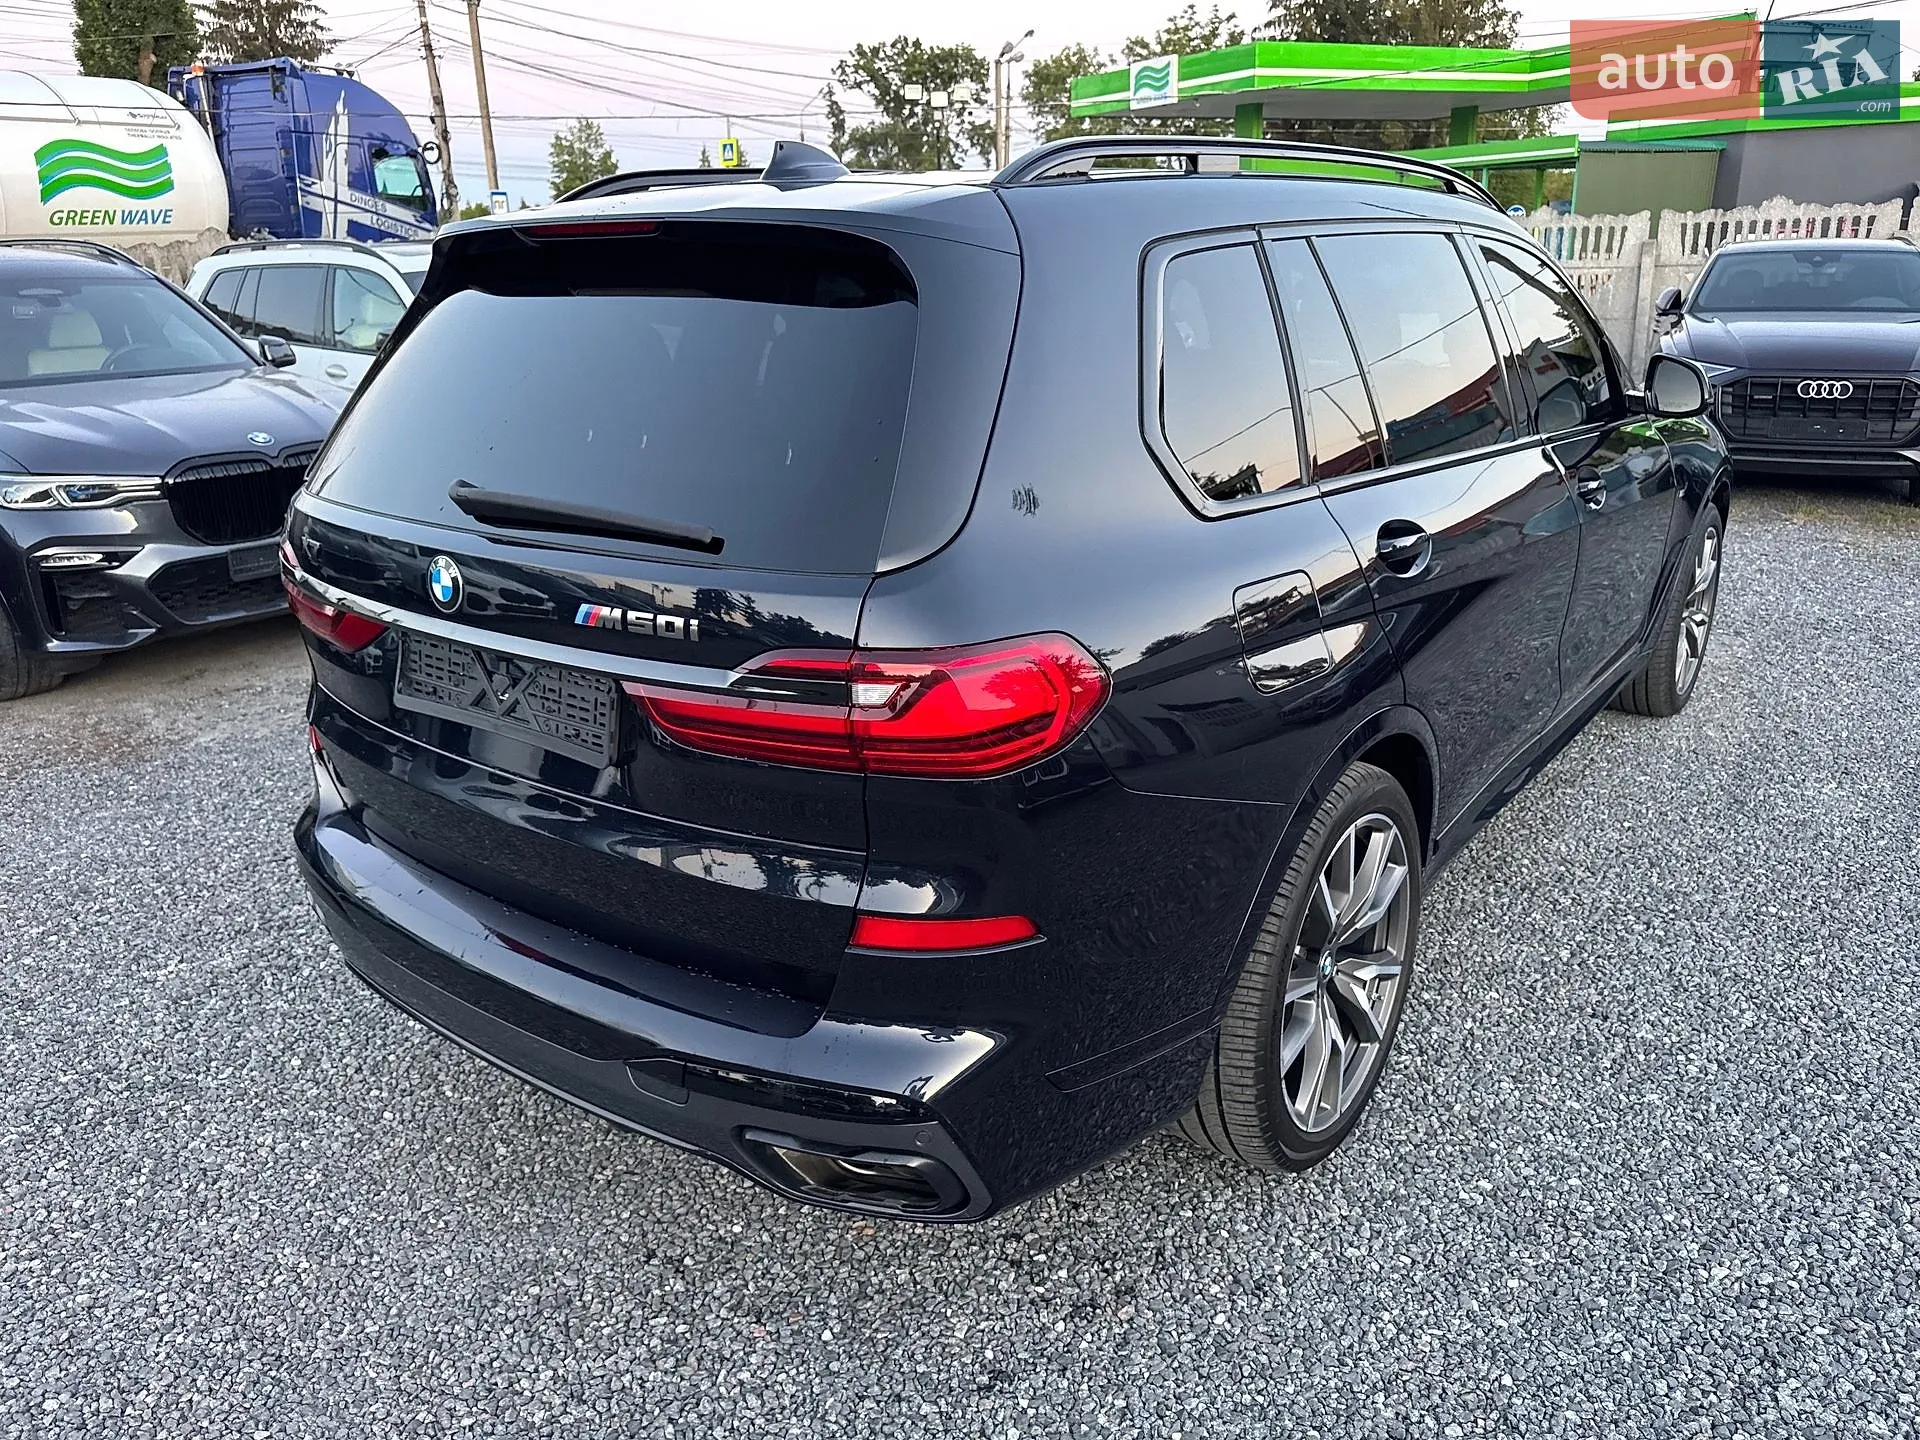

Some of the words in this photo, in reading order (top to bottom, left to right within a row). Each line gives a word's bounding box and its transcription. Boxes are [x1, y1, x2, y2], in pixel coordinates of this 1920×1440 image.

[349, 192, 388, 213] DINGES
[49, 209, 117, 226] GREEN
[120, 208, 174, 225] WAVE
[370, 214, 420, 238] LOGISTICS
[596, 606, 700, 642] M50i
